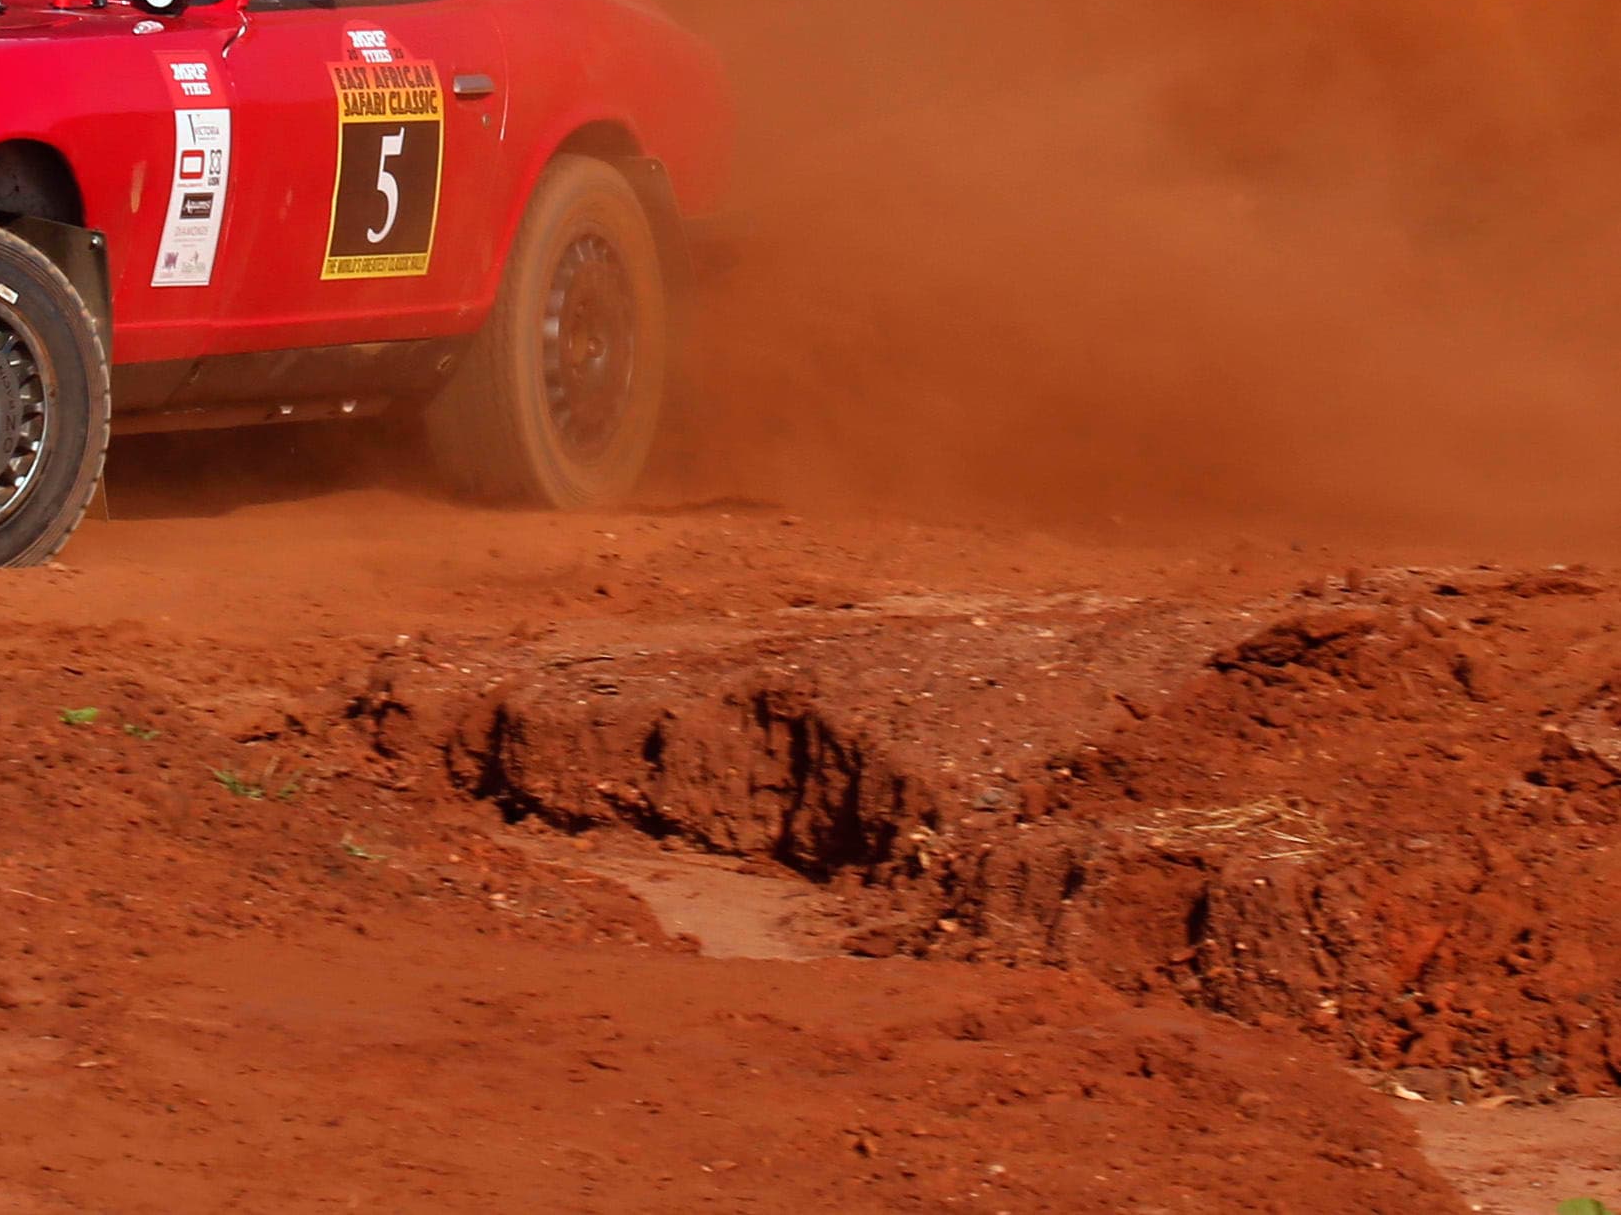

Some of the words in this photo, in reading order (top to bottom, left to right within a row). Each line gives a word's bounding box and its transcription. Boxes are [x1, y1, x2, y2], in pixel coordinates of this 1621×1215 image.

[347, 30, 387, 48] MRF
[170, 63, 208, 80] MRF
[334, 67, 370, 90] EAST
[372, 64, 435, 89] AFRICAN
[344, 91, 386, 116] SAFARI
[388, 89, 438, 116] CLASSIC
[366, 127, 405, 243] 5
